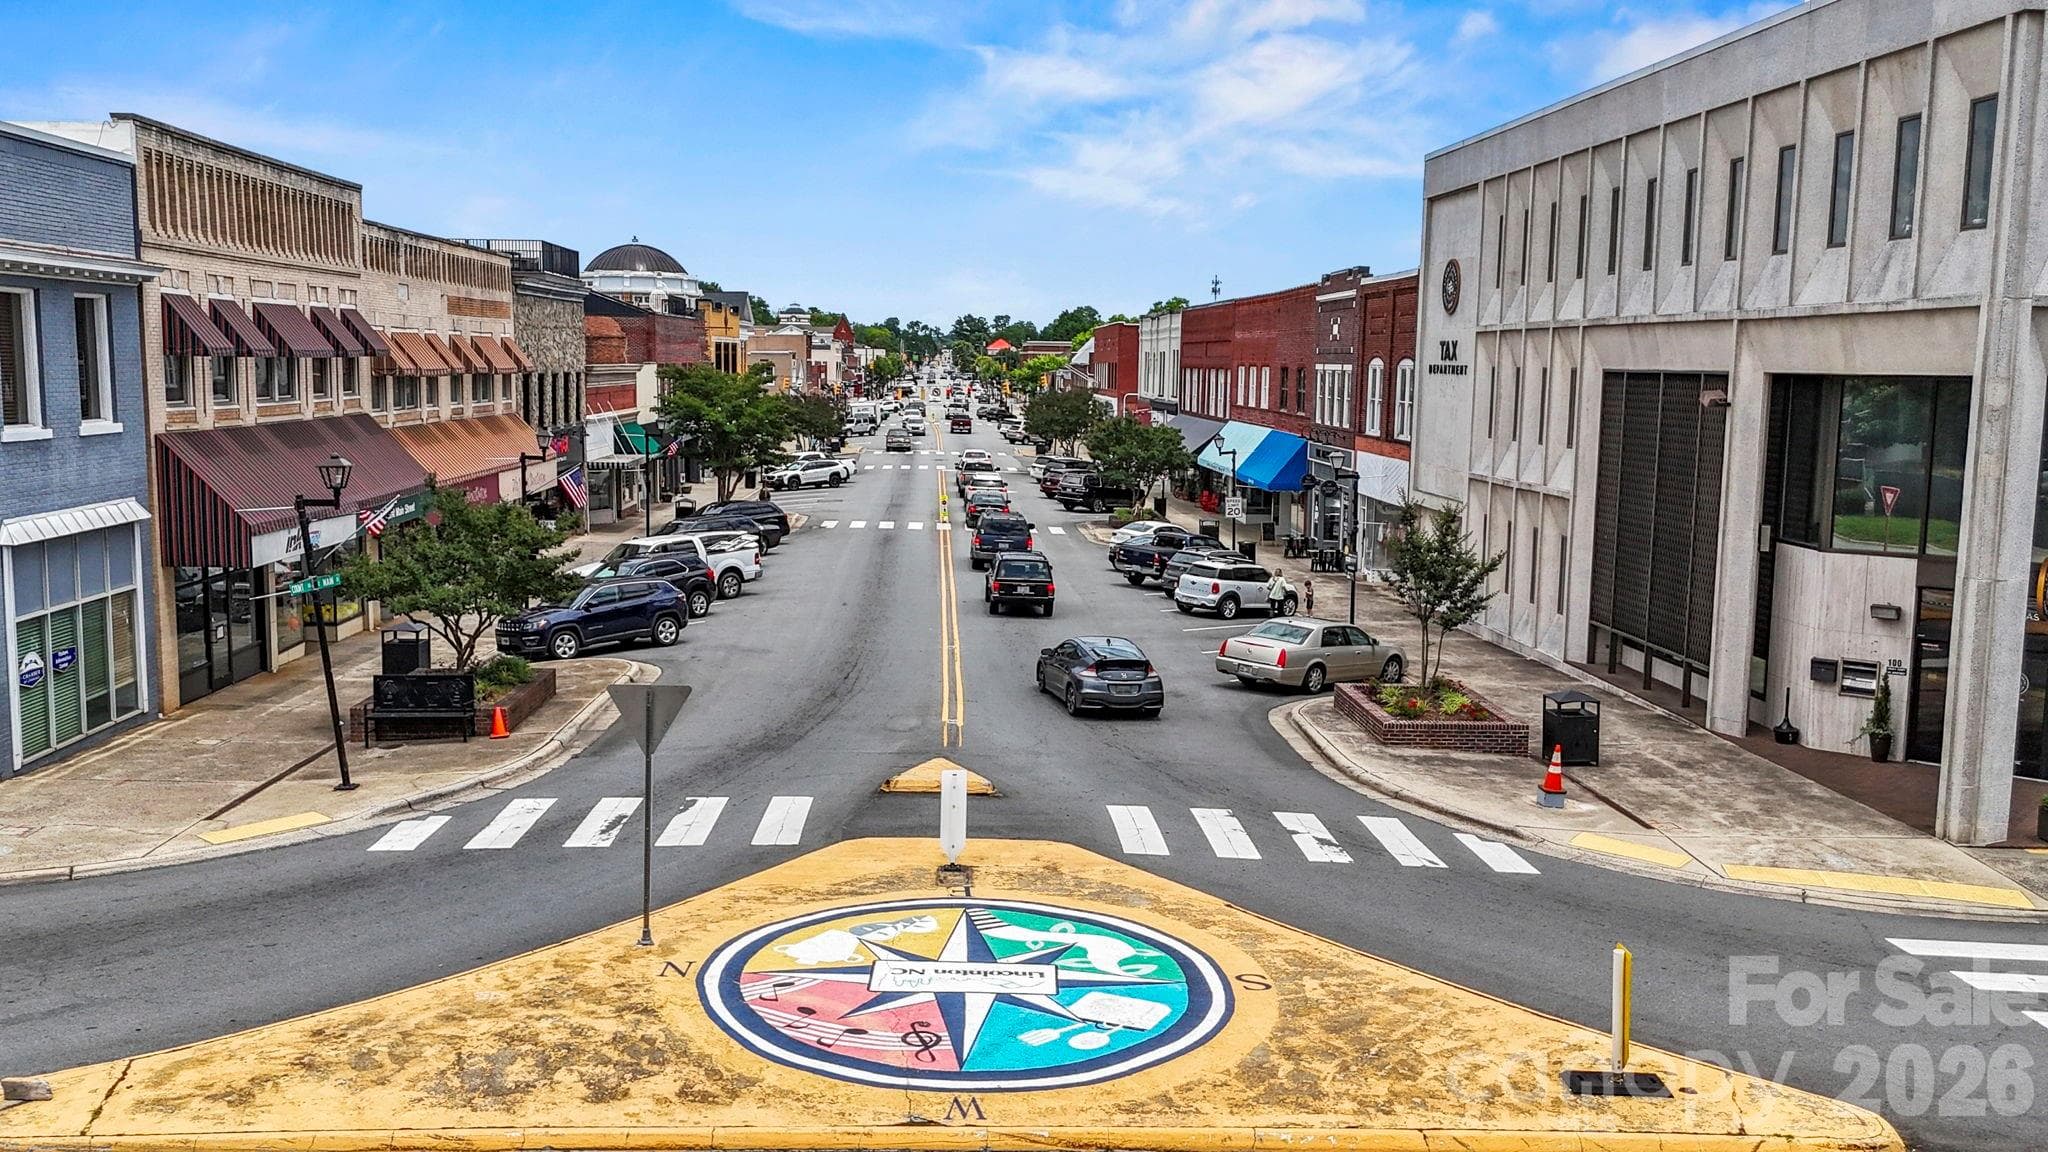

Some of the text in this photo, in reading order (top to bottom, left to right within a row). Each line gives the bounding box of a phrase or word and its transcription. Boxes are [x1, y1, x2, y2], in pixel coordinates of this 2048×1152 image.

[1440, 340, 1457, 361] TAX
[1429, 364, 1468, 375] DEPARTMENT
[1227, 507, 1241, 516] 20
[322, 576, 335, 586] MAIN
[1888, 659, 1902, 667] 100
[656, 961, 697, 977] N
[890, 967, 1045, 979] Lincolnton NC
[1235, 973, 1272, 991] S
[943, 1096, 987, 1120] W
